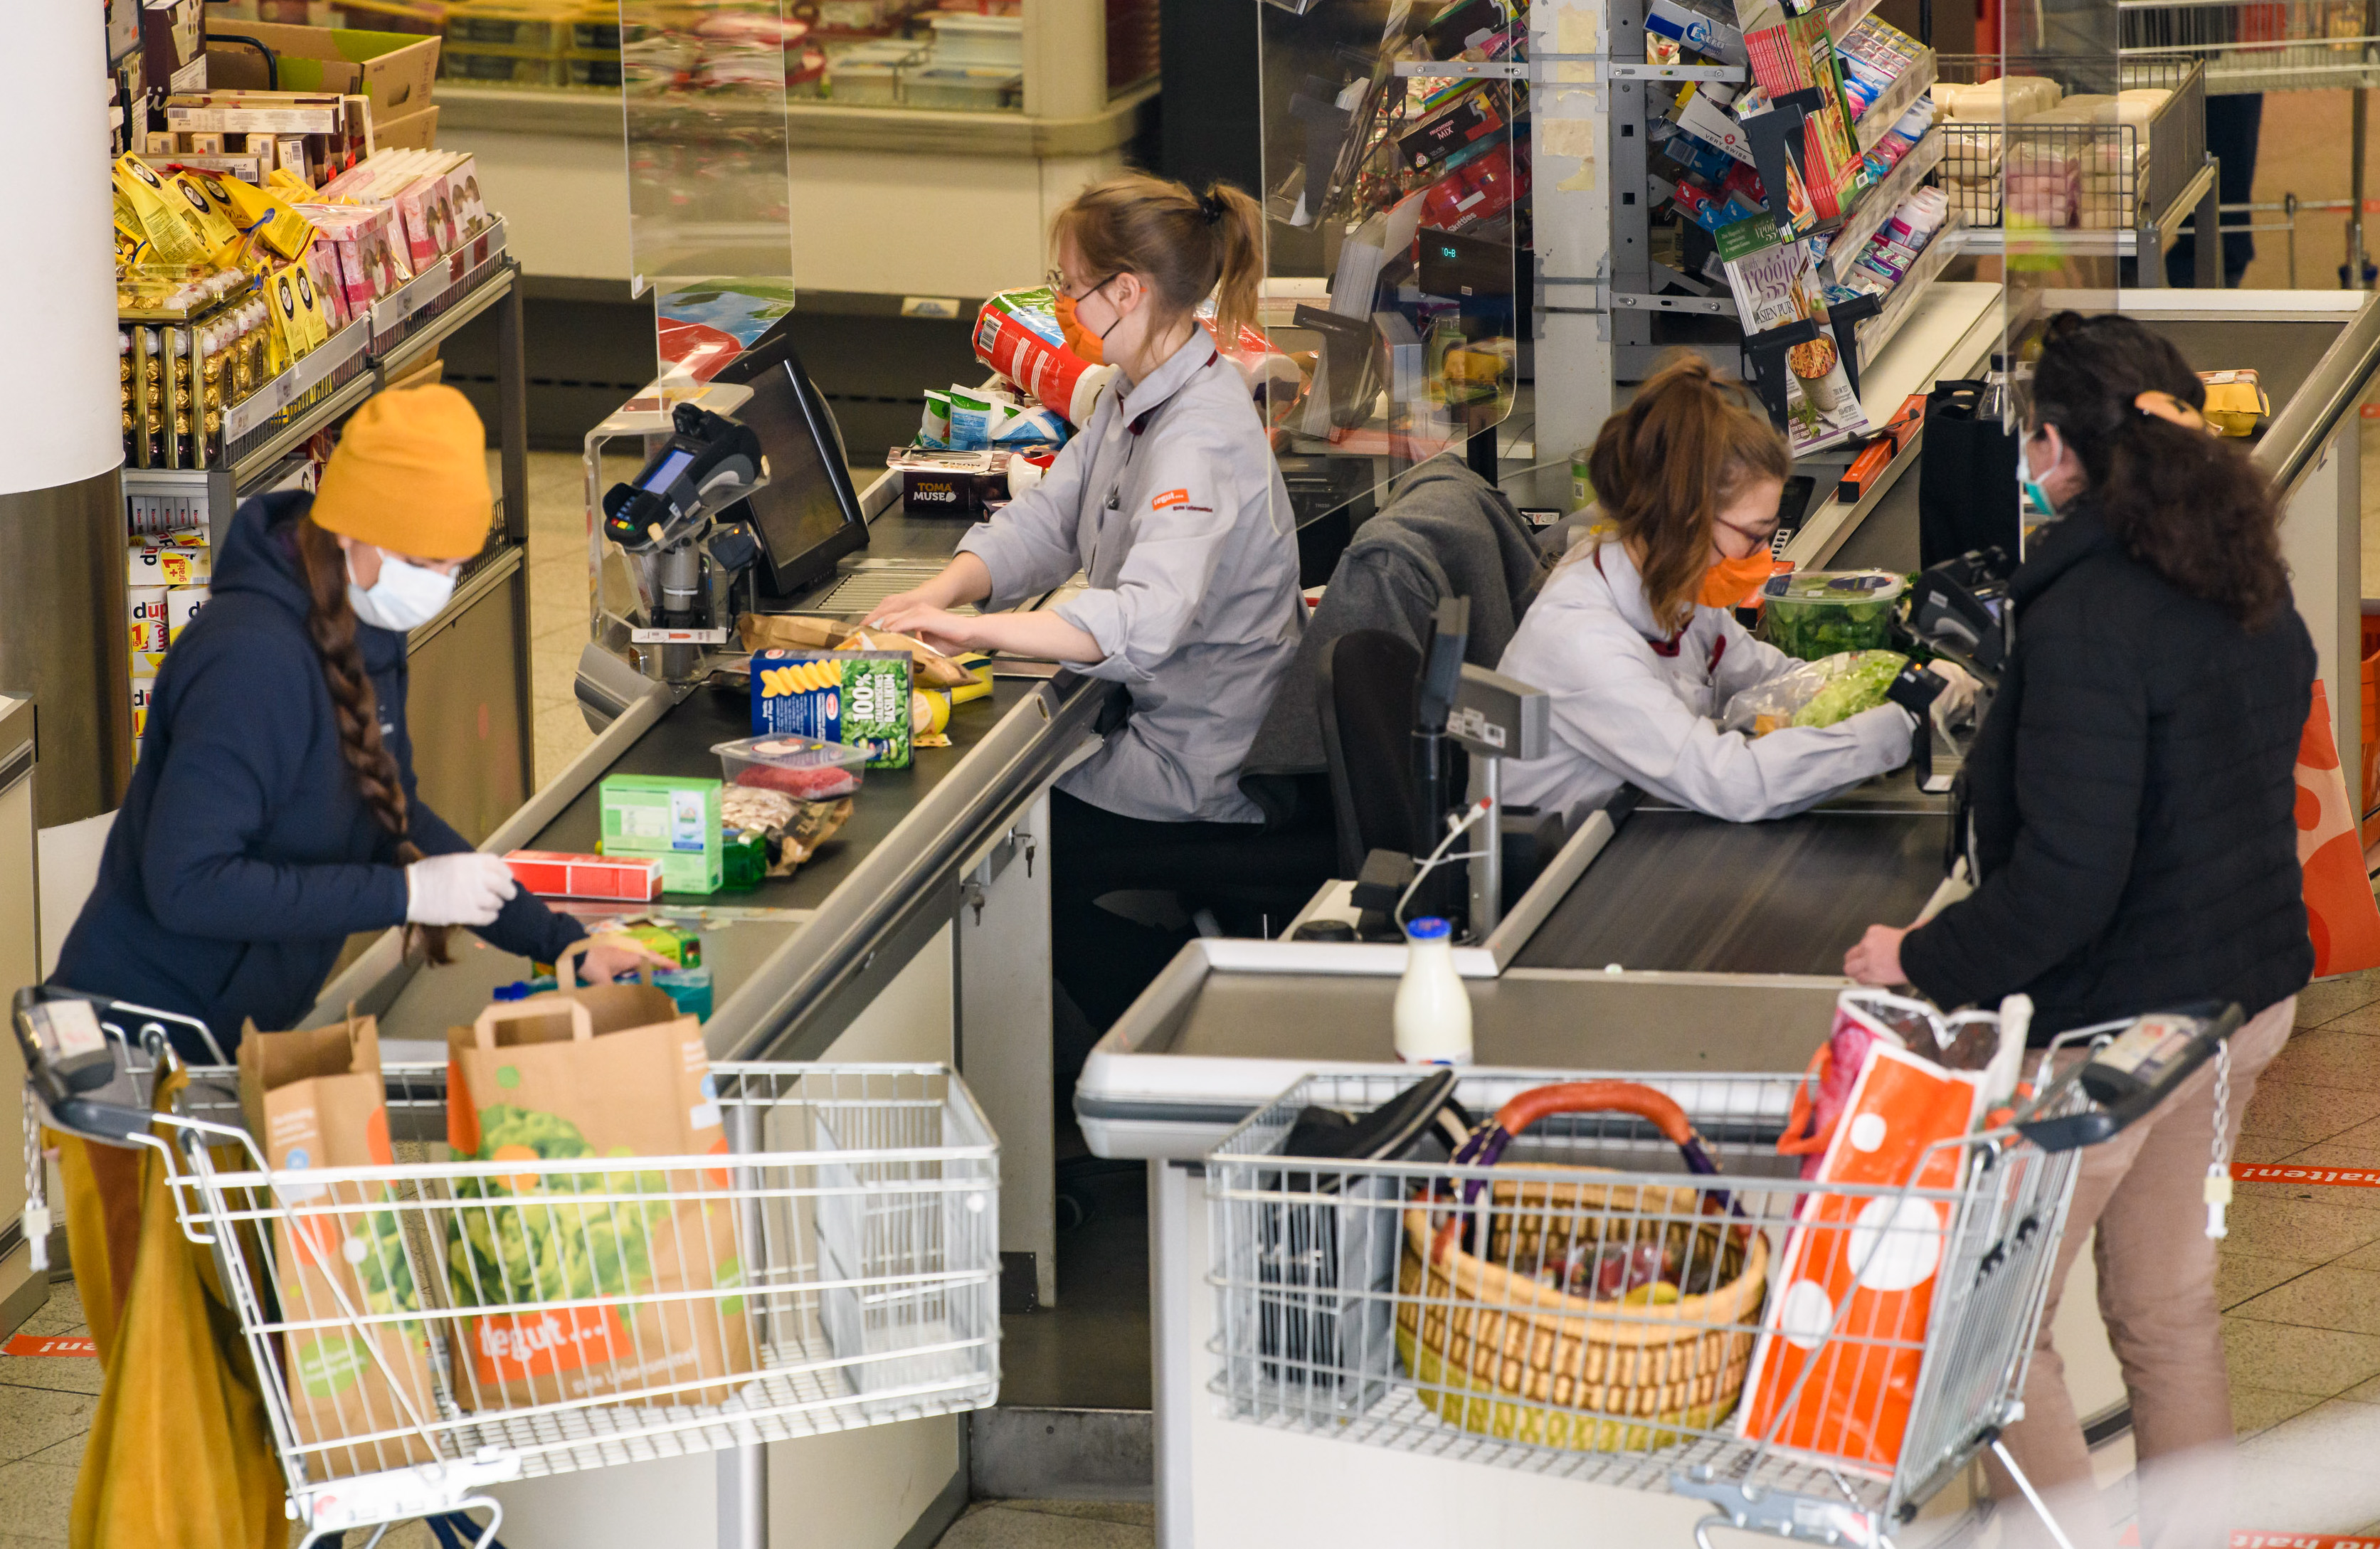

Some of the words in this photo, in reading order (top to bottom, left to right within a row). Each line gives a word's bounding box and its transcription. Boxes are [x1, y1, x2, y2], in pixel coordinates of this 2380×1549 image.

[1691, 26, 1726, 49] Extra
[1429, 120, 1454, 136] FRUCHTIGER
[1437, 127, 1454, 140] MIX
[1705, 134, 1723, 146] VERY
[1725, 146, 1747, 160] SWISS
[1447, 213, 1477, 231] Skittles
[1756, 307, 1778, 324] ASIEN
[1778, 301, 1795, 316] PUR
[1153, 492, 1184, 506] tegut...
[177, 561, 187, 582] gratis
[133, 602, 168, 620] dup
[852, 673, 874, 722] 100%
[874, 674, 884, 722] ITALIENISCHES
[884, 673, 896, 722] BASILIKUM
[2242, 1168, 2380, 1184] halten!
[480, 1316, 604, 1362] tegut...
